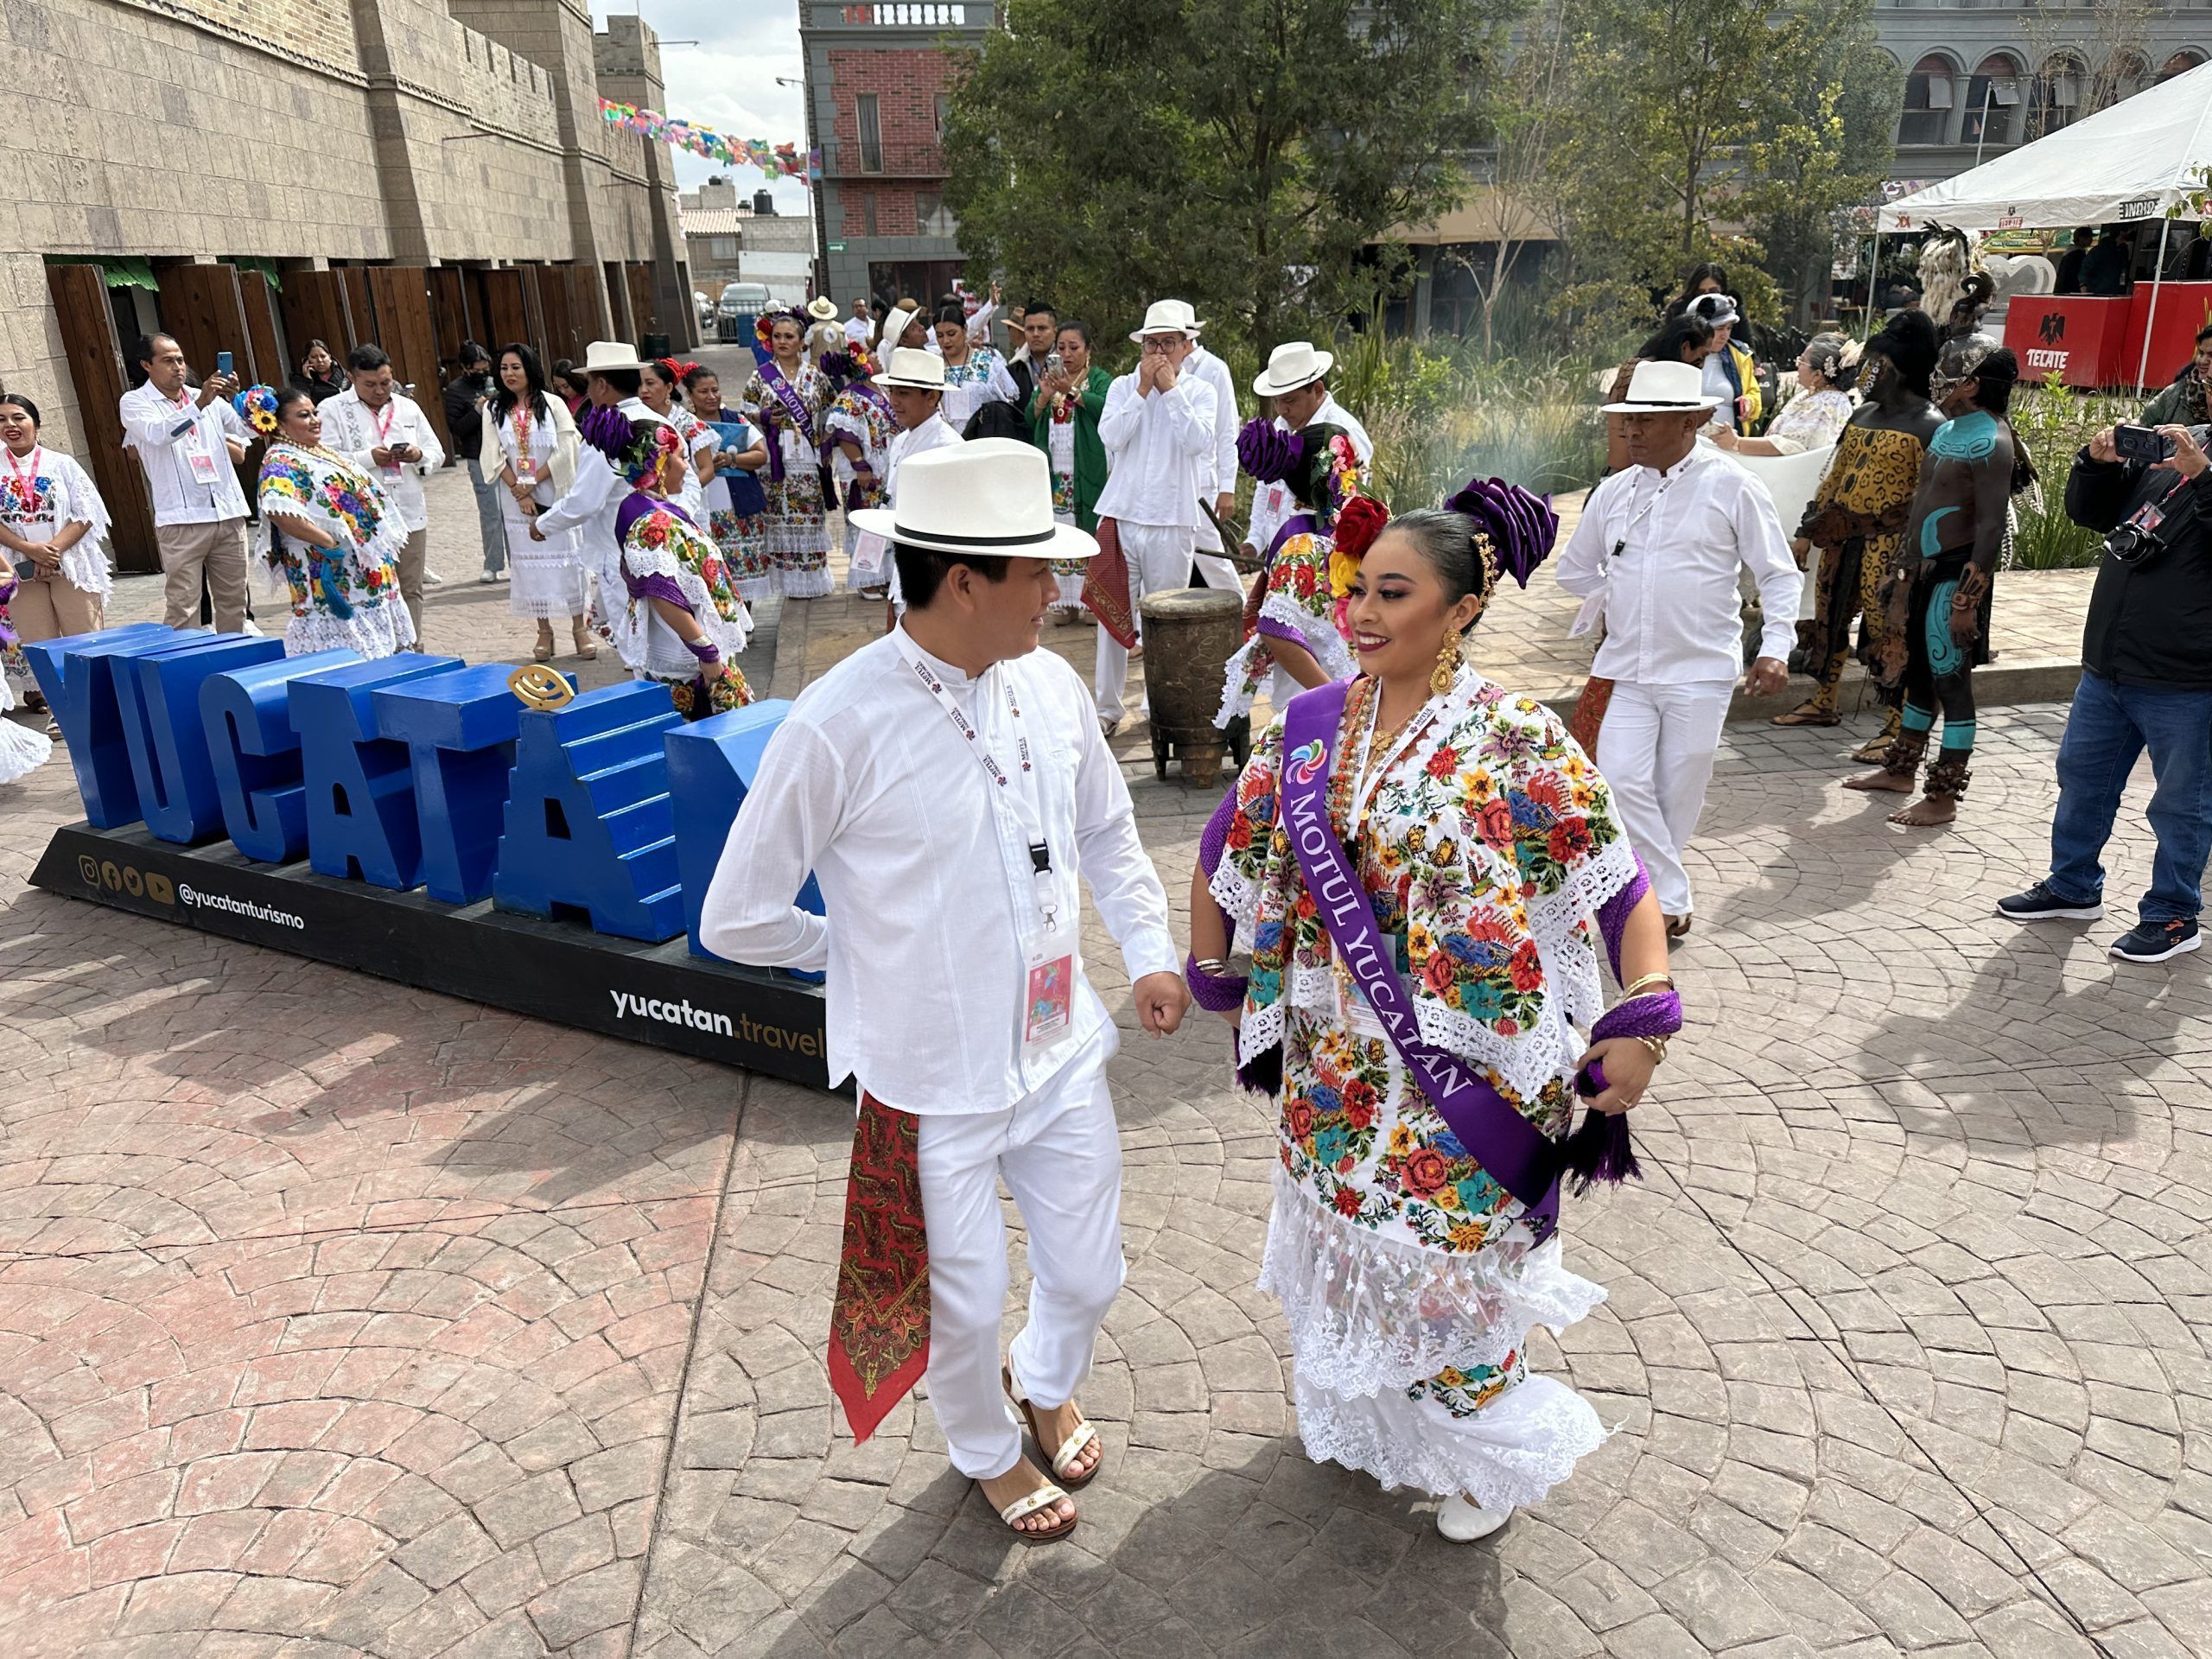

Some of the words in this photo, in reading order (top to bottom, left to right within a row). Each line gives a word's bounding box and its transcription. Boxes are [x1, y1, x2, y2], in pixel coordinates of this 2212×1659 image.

[2125, 200, 2156, 218] INDIO
[1999, 218, 2023, 229] TECATE
[2025, 348, 2070, 369] TECATE
[782, 391, 809, 426] MOTUL
[914, 663, 933, 685] MOTUL
[950, 710, 968, 732] MOTUL
[1414, 708, 1433, 726] MOTUL
[982, 756, 999, 779] MOTUL
[178, 883, 305, 930] @yucatanturismo
[1290, 790, 1361, 927] MOTUL
[1344, 925, 1474, 1099] YUCATÁN
[609, 989, 826, 1059] yucatan.travel
